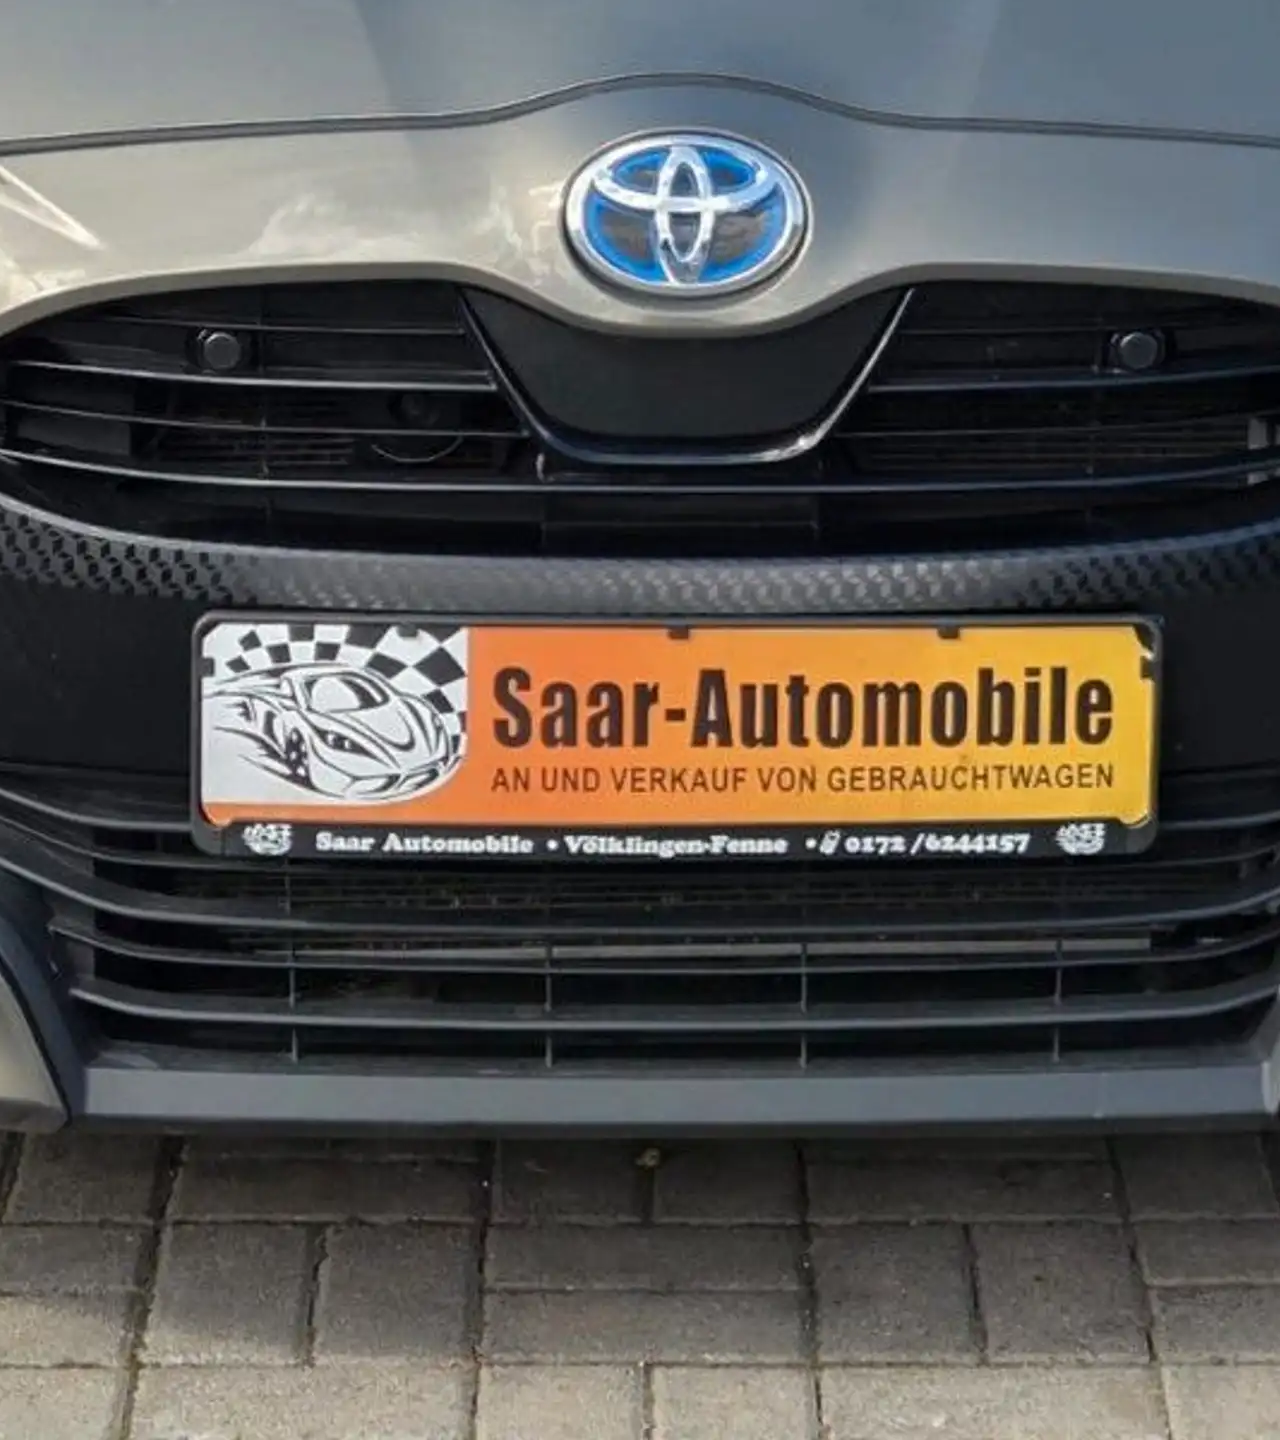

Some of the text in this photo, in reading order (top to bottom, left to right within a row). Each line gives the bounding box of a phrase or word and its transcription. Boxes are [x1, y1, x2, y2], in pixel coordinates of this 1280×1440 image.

[492, 665, 1114, 749] Saar-Automobile
[491, 763, 1115, 793] AN UND VERKAUF VON GEBRAUCHTWAGEN
[315, 831, 375, 852] Saar
[382, 832, 534, 853] Automobile
[844, 835, 905, 855] 0172
